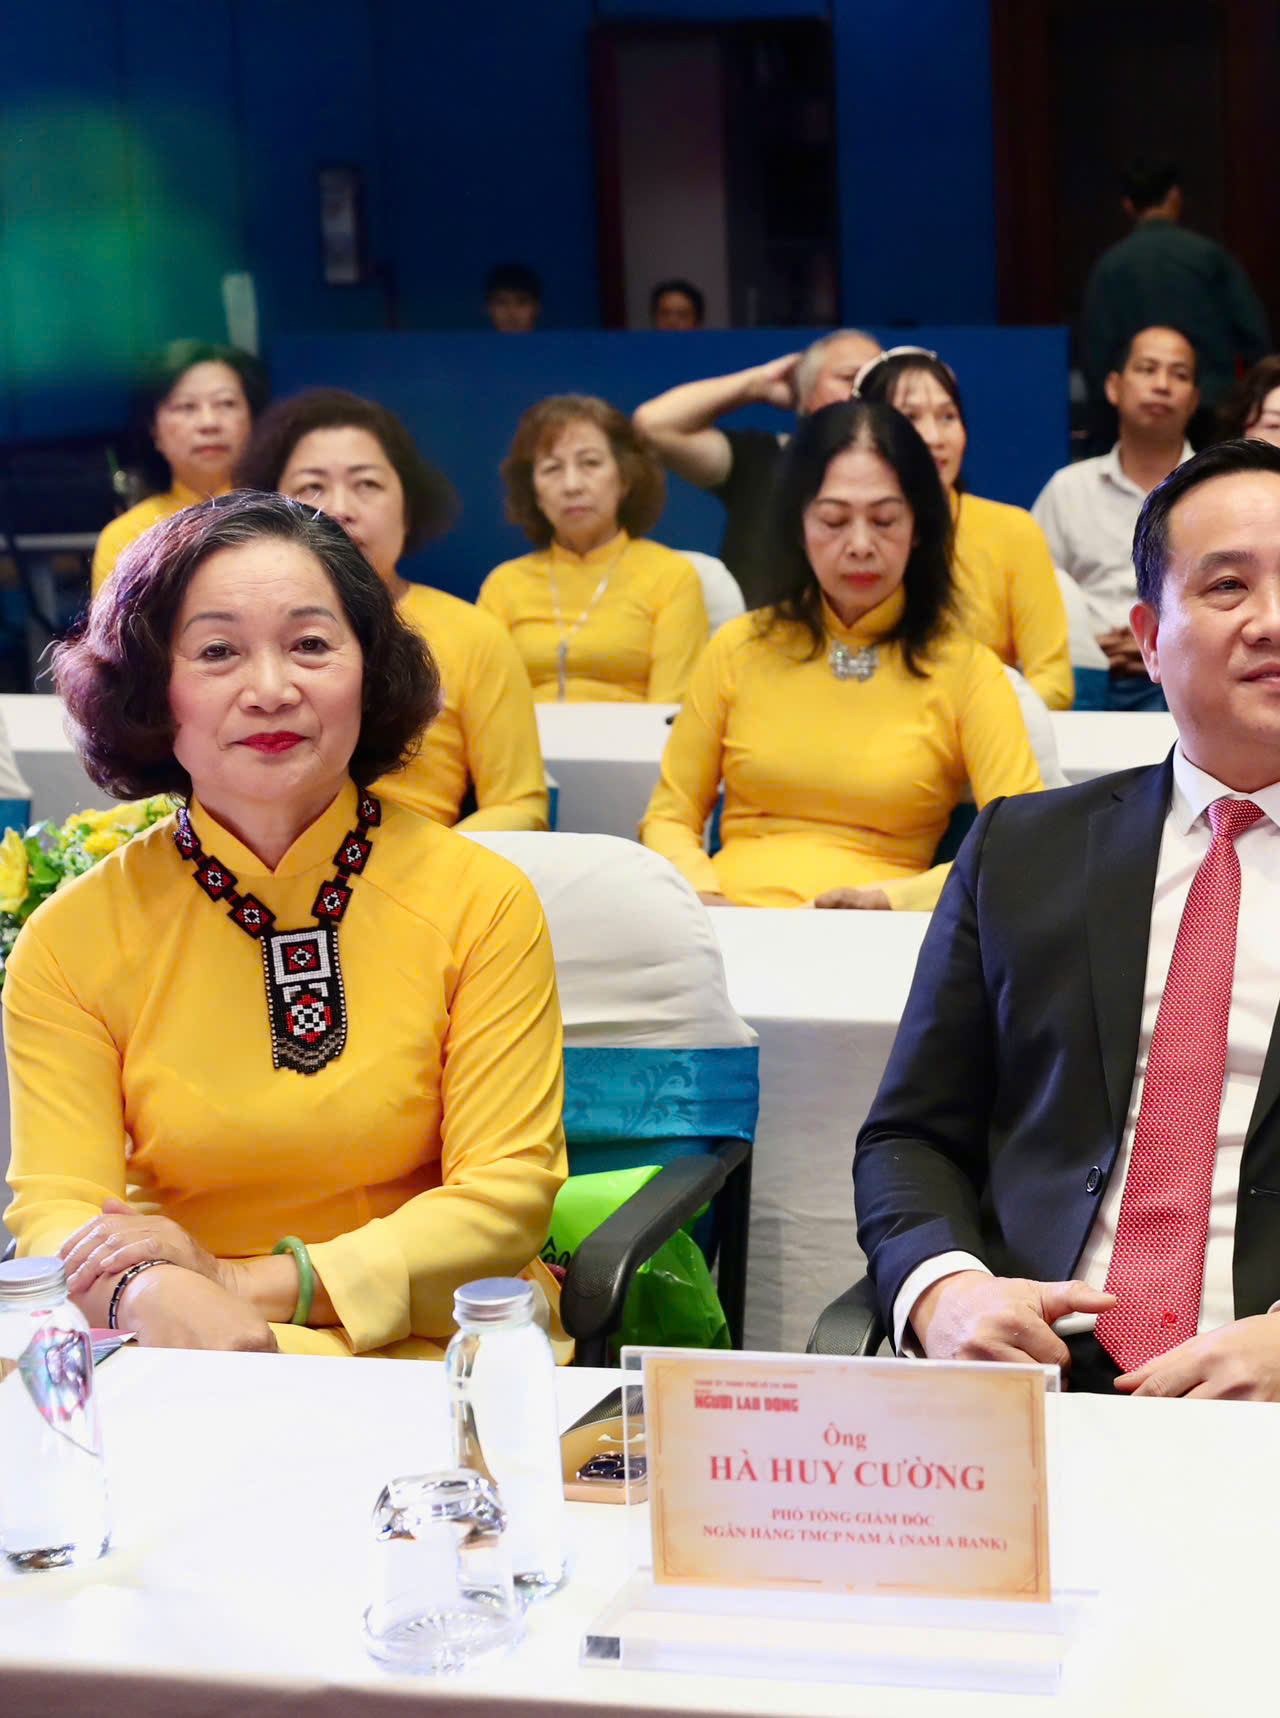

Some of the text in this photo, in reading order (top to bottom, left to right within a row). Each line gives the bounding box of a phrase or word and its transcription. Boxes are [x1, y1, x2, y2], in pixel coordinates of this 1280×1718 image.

[823, 1421, 867, 1450] Ông
[710, 1450, 985, 1491] HÀ HUY CƯỜNG
[703, 1522, 747, 1539] NGÂN
[798, 1529, 842, 1543] TMCP
[846, 1531, 881, 1545] NAM
[899, 1533, 941, 1548] (NAM
[958, 1536, 1008, 1552] BANK)
